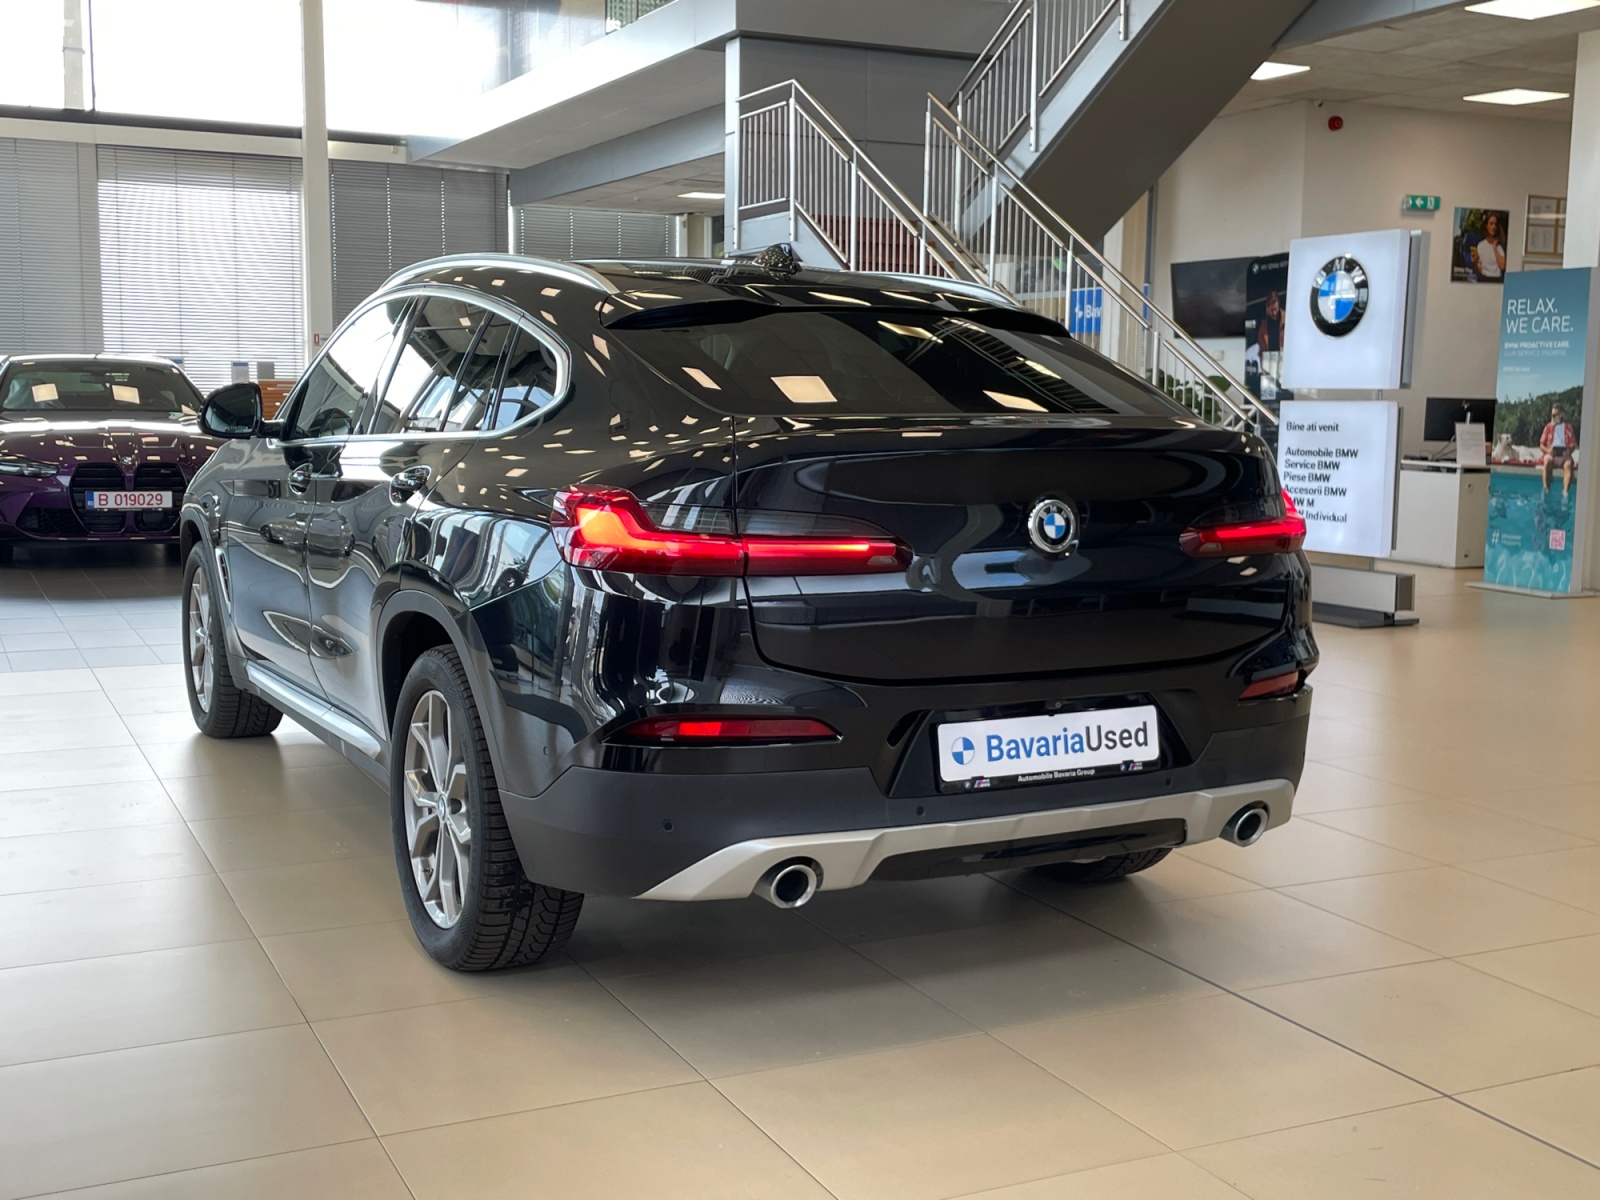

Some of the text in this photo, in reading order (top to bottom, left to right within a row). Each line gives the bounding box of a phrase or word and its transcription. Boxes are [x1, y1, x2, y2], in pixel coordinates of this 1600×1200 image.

[1507, 297, 1558, 315] RELAX.
[1505, 315, 1575, 334] WE CARE.
[1286, 421, 1339, 432] Bine ati venit
[1285, 446, 1359, 459] Automobile BMW
[1284, 459, 1341, 471] Service BMW
[1283, 471, 1331, 483] Piese BMW
[1284, 484, 1347, 497] Accesorii BMW
[98, 493, 109, 507] B
[114, 493, 163, 507] 019029
[1306, 498, 1315, 508] M
[1305, 510, 1347, 523] Individual
[1017, 768, 1096, 783] Automobile Bavaria Group
